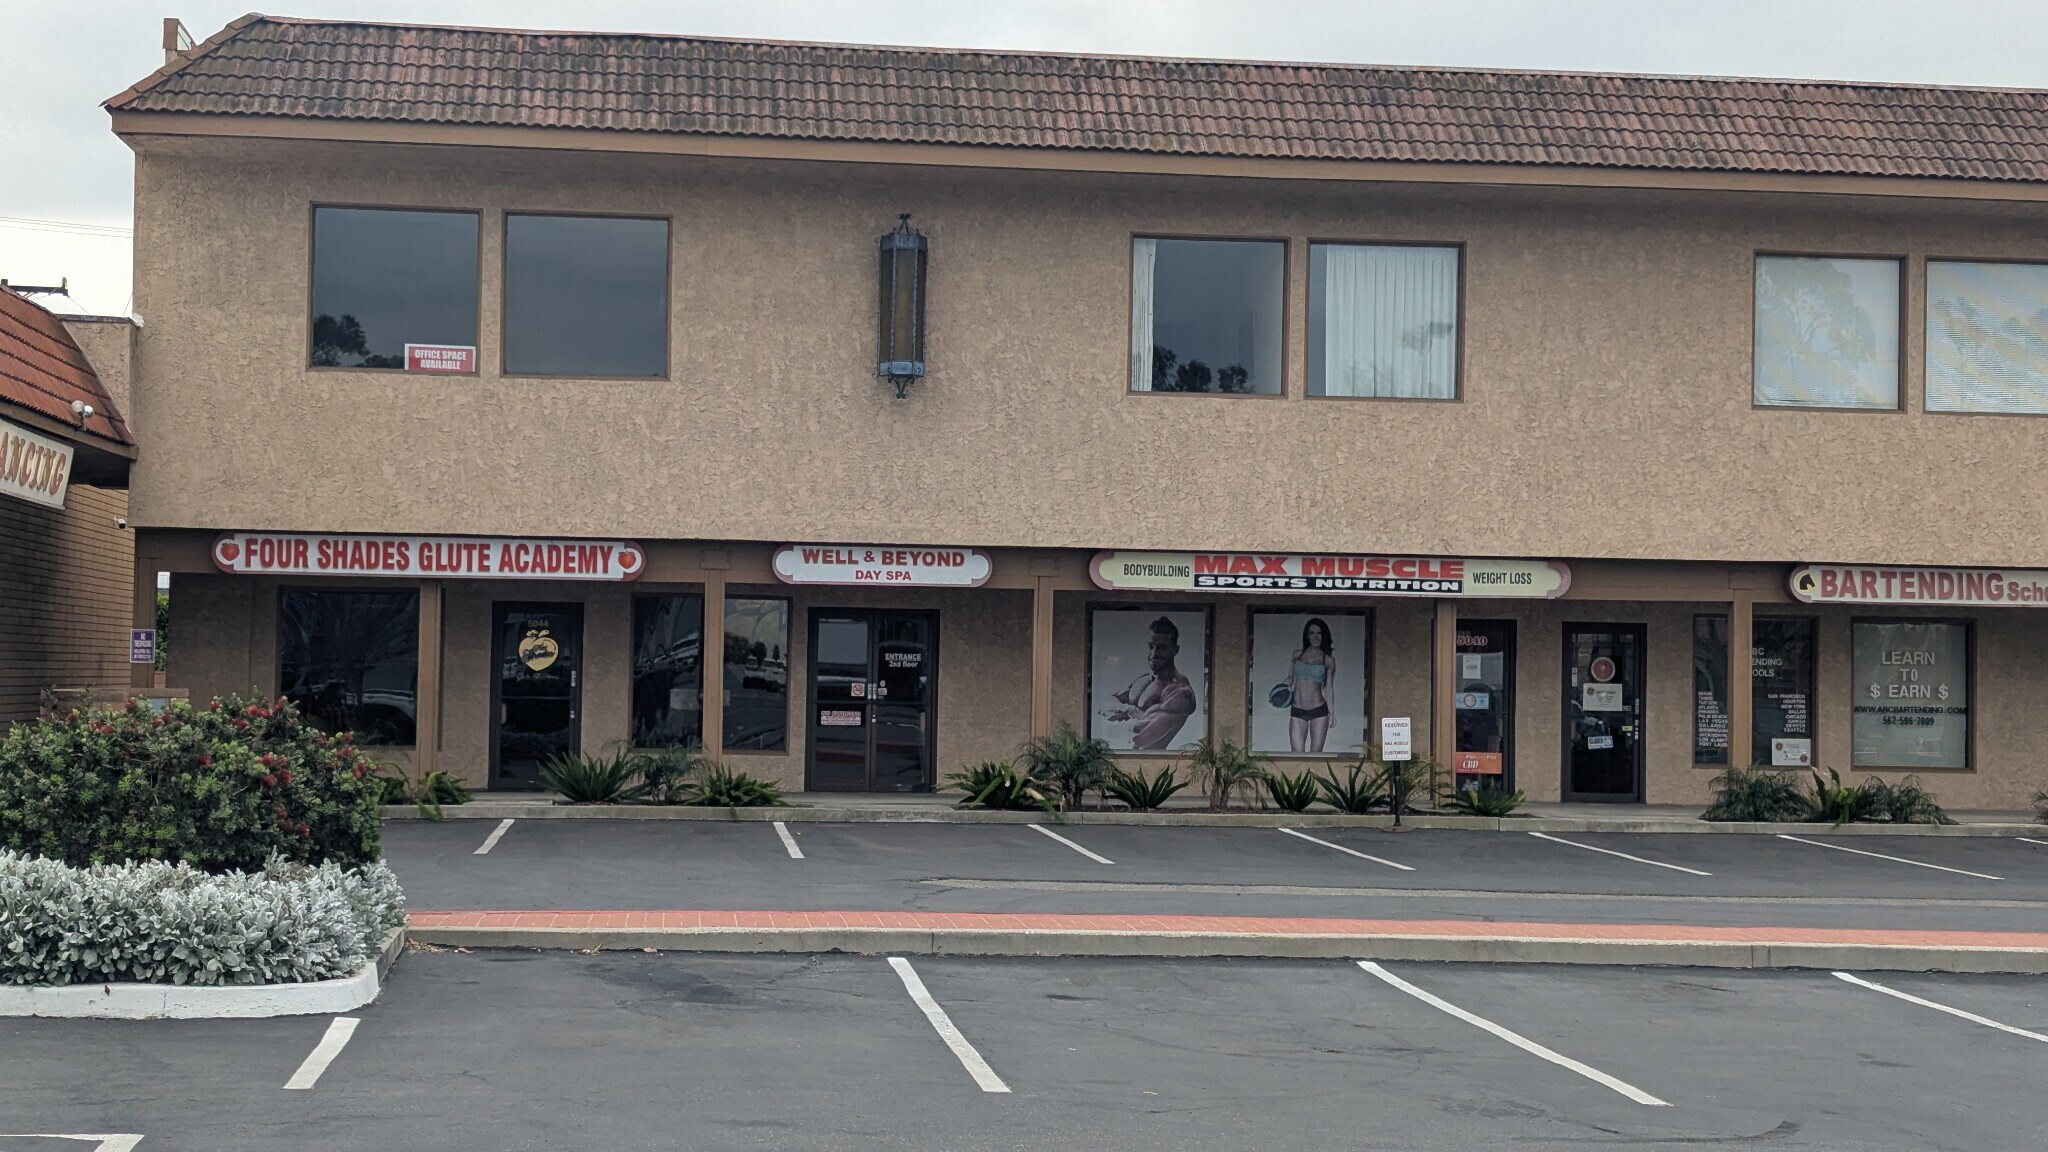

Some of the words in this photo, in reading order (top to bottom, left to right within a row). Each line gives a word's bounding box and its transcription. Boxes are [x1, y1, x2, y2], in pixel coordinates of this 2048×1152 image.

[414, 349, 441, 360] OFFICE
[442, 350, 467, 361] SPACE
[420, 360, 461, 370] AVAILABLE
[244, 537, 309, 569] FOUR
[317, 538, 410, 571] SHADES
[418, 541, 491, 573] GLUTE
[498, 543, 614, 574] ACADEMY
[802, 548, 859, 565] WELL
[863, 550, 876, 563] &
[881, 550, 965, 567] BEYOND
[1123, 563, 1190, 577] BODYBUILDING
[1194, 554, 1288, 575] MAX
[1301, 556, 1464, 579] MUSCLE
[855, 570, 882, 580] DAY
[885, 570, 912, 581] SPA
[1472, 571, 1507, 585] WEIGHT
[1509, 572, 1533, 585] LOSS
[1197, 576, 1308, 588] SPORTS
[1315, 578, 1459, 592] NUTRITION
[1820, 569, 2004, 601] BARTENDING
[527, 619, 549, 627] 5044
[1456, 635, 1489, 646] 5040
[885, 652, 922, 661] ENTRANCE
[1752, 647, 1765, 656] BC
[888, 660, 901, 668] 2nd
[902, 660, 919, 668] floor
[1751, 658, 1783, 666] ENDING
[1882, 651, 1936, 665] LEARN
[1752, 668, 1775, 677] OOLS
[1870, 683, 1881, 700] $
[1888, 684, 1932, 698] EARN
[1937, 683, 1949, 701] $
